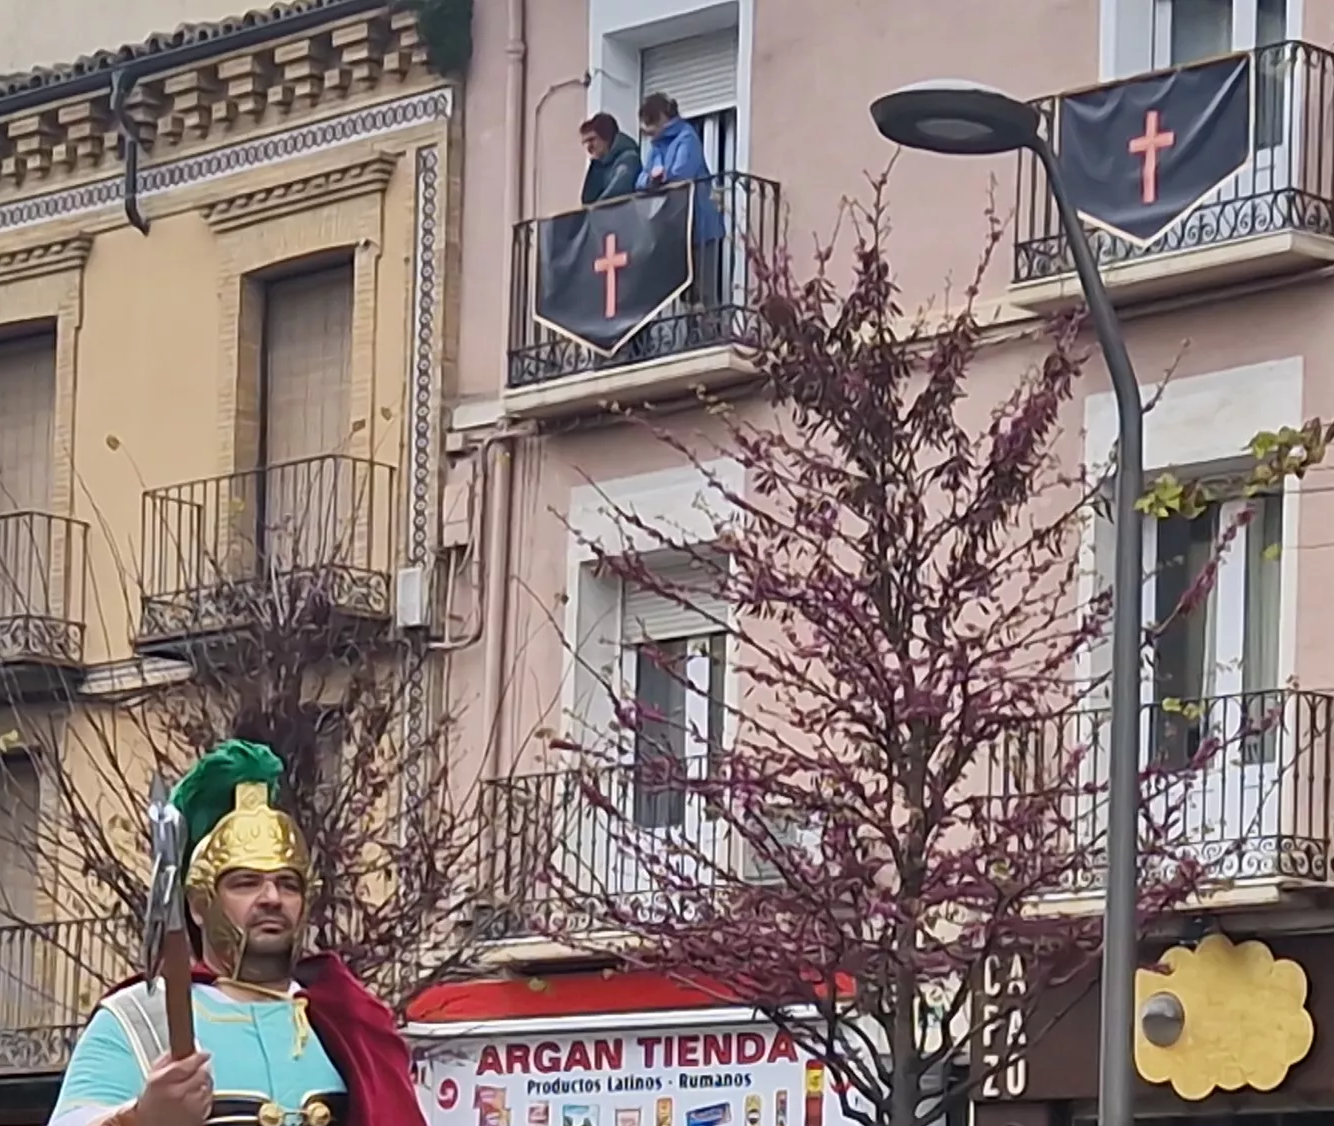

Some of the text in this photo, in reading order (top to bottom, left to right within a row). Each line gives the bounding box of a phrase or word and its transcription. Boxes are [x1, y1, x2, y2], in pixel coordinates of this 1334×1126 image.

[477, 1030, 798, 1077] ARGAN TIENDA
[526, 1073, 602, 1096] Productos
[607, 1073, 663, 1094] Latinos
[679, 1071, 752, 1090] Rumanos
